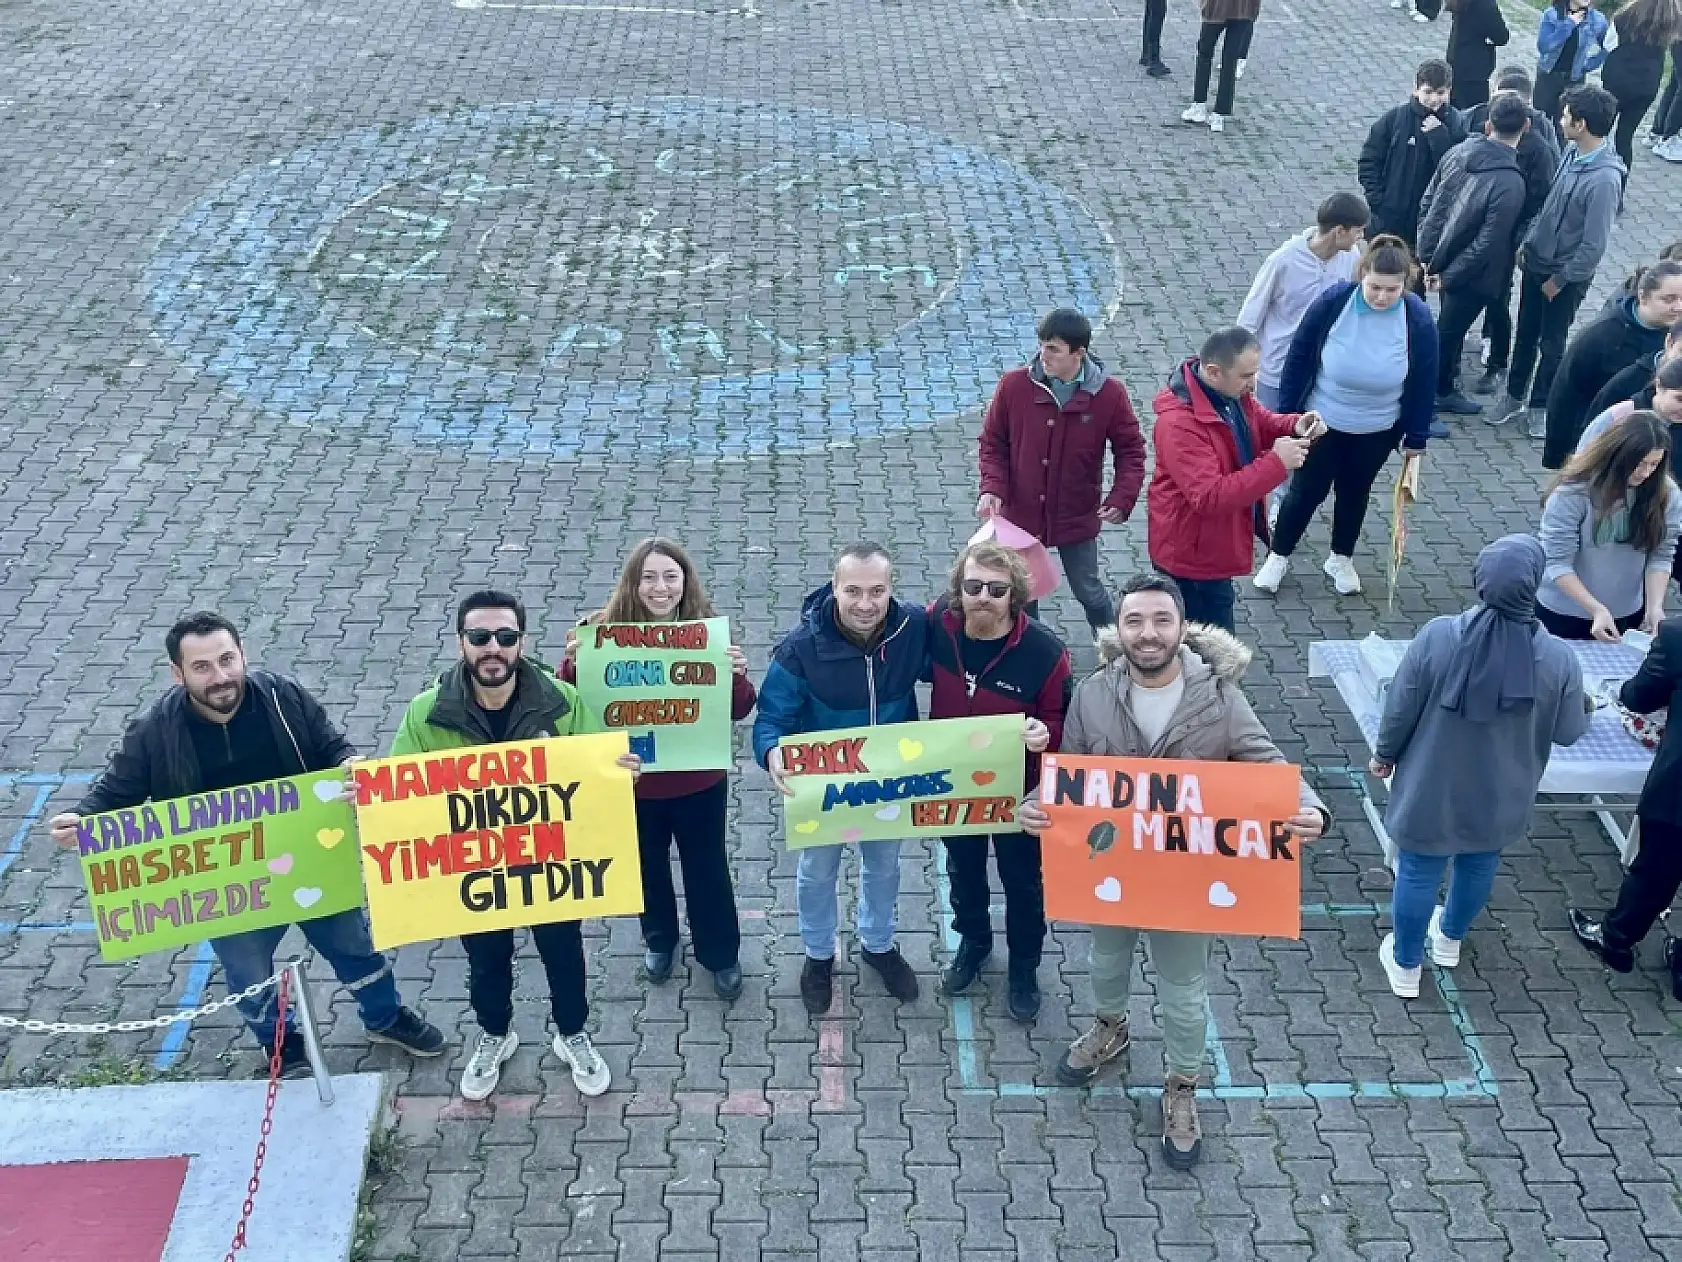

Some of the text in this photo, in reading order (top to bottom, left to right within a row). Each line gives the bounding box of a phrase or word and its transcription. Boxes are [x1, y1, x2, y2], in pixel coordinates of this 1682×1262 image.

[354, 746, 547, 806] MANCARI
[1041, 757, 1204, 814] İNADINA
[77, 780, 300, 857] KARA LAHANA
[448, 781, 580, 833] DİKDİY
[911, 796, 1016, 826] BETTER
[362, 821, 567, 885] YİMEDEN
[1132, 811, 1294, 861] MANCAR
[460, 857, 614, 912] GİTDİY
